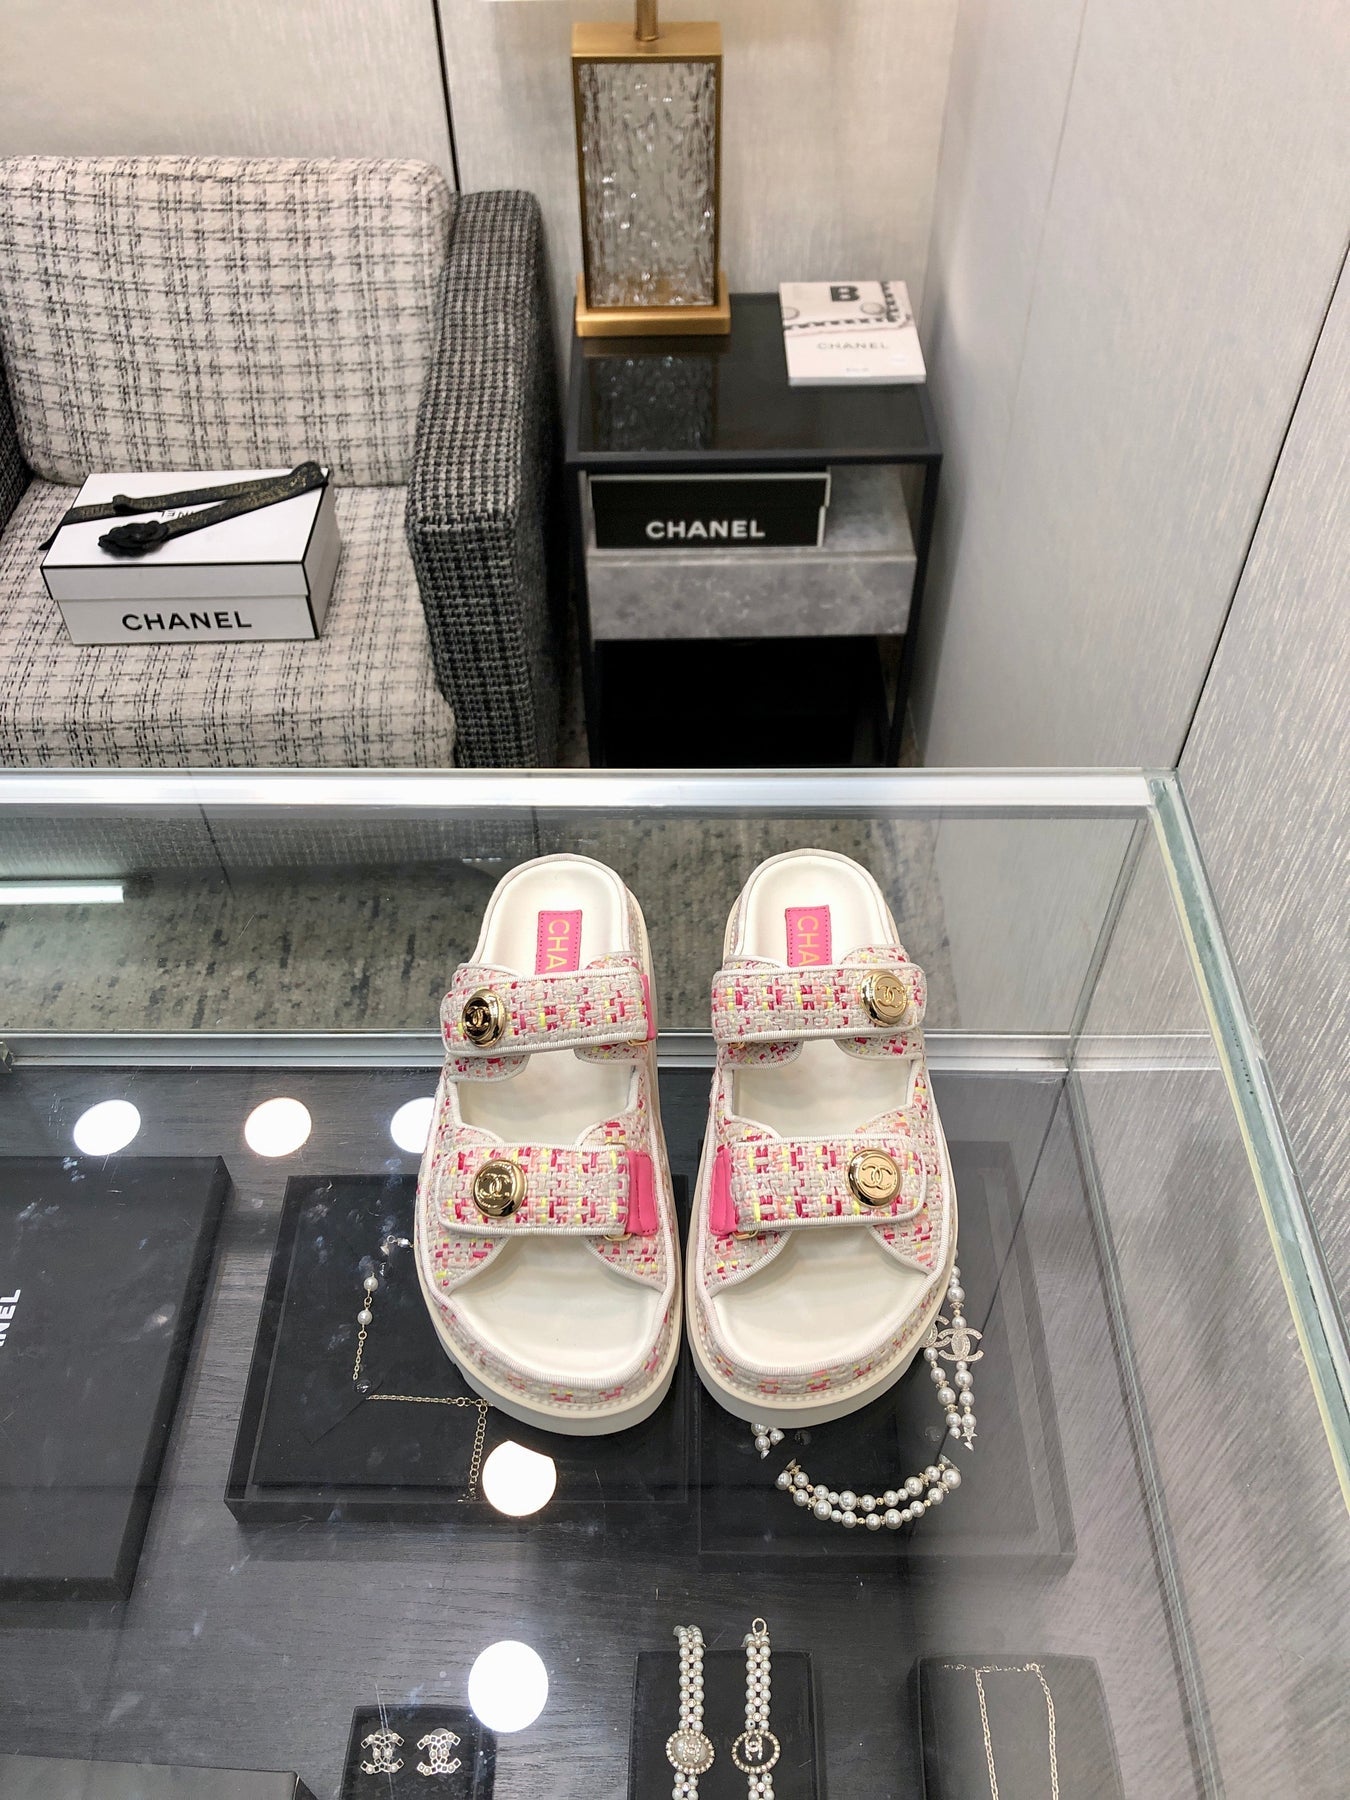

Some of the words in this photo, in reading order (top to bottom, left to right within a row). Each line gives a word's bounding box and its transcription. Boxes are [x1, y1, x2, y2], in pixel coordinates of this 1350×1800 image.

[829, 286, 860, 302] B
[817, 342, 889, 350] CHANEL
[646, 520, 765, 539] CHANEL
[122, 610, 252, 631] CHANEL
